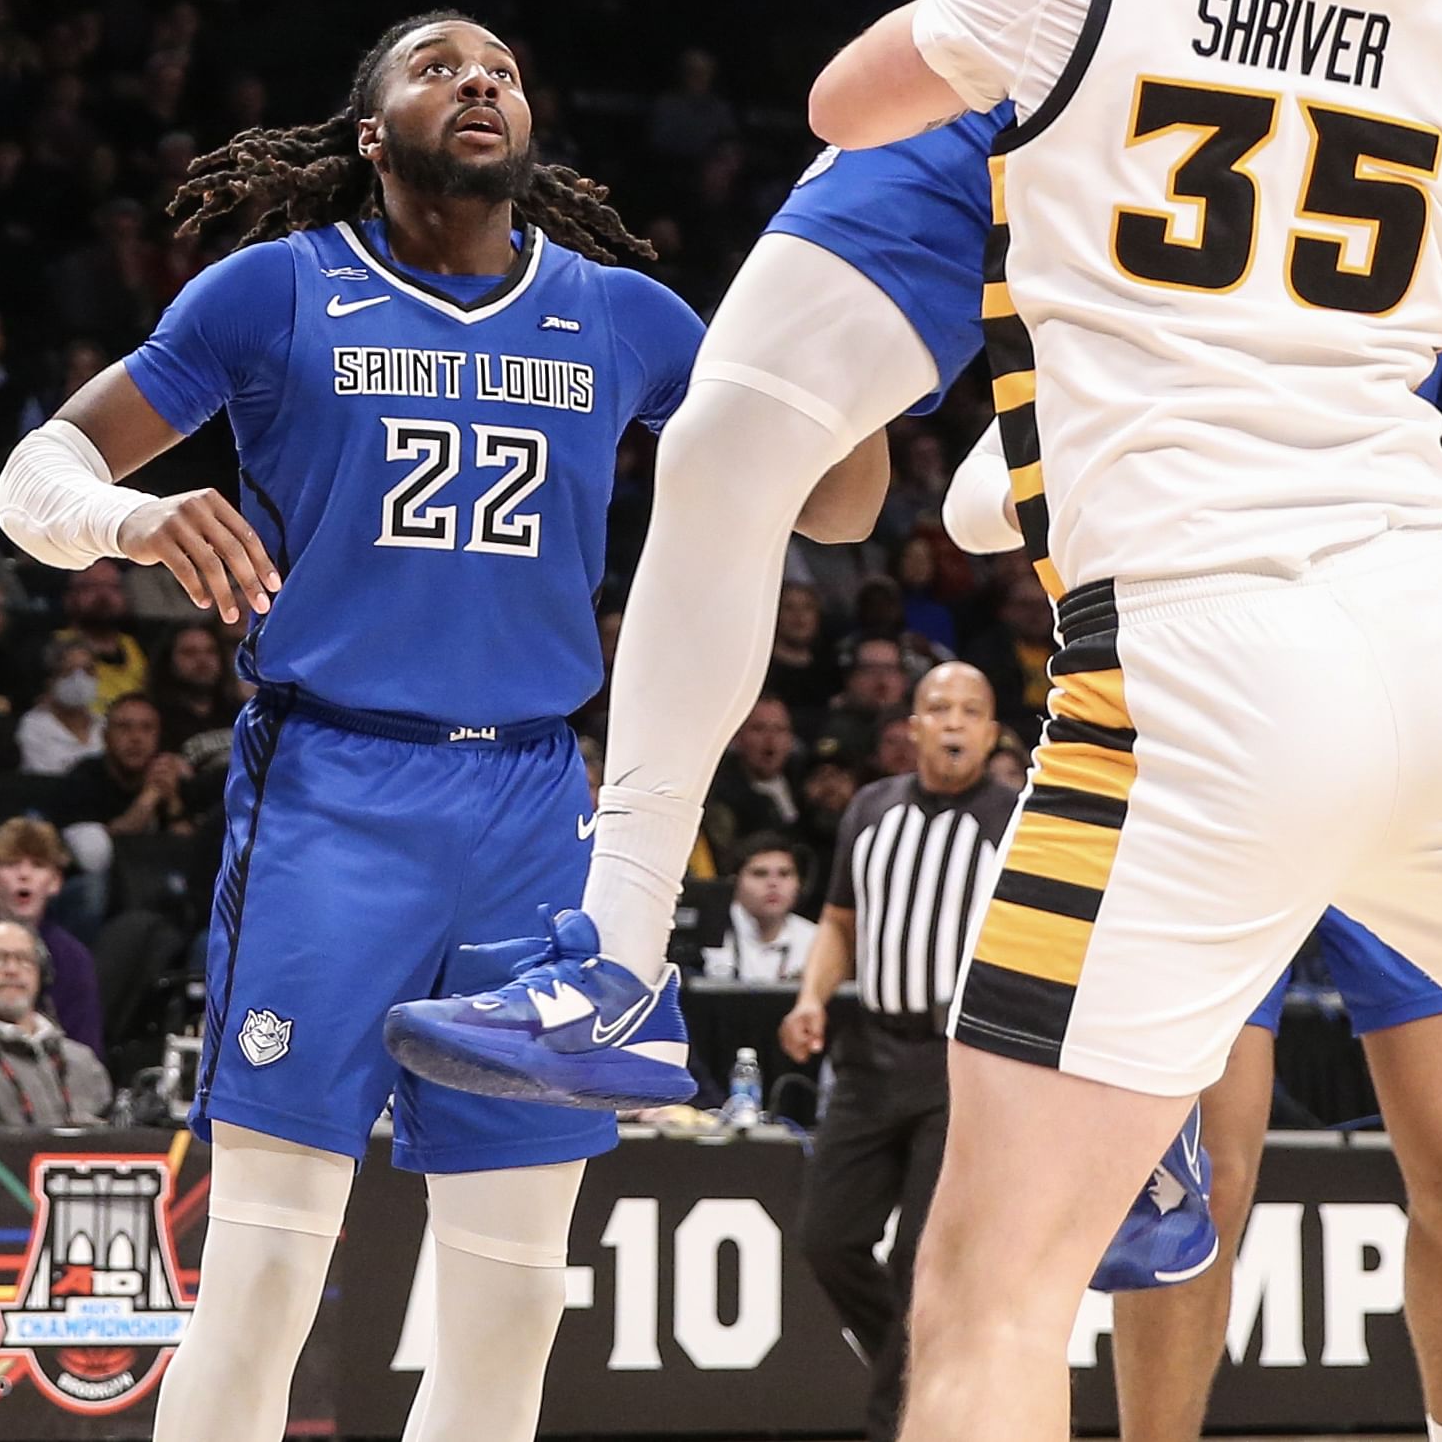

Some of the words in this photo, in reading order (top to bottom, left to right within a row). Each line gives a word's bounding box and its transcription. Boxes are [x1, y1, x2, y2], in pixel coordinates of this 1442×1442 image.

[1109, 73, 1442, 319] 35
[332, 346, 467, 399] SAINT
[475, 353, 595, 414] LOUIS
[373, 416, 549, 558] 22
